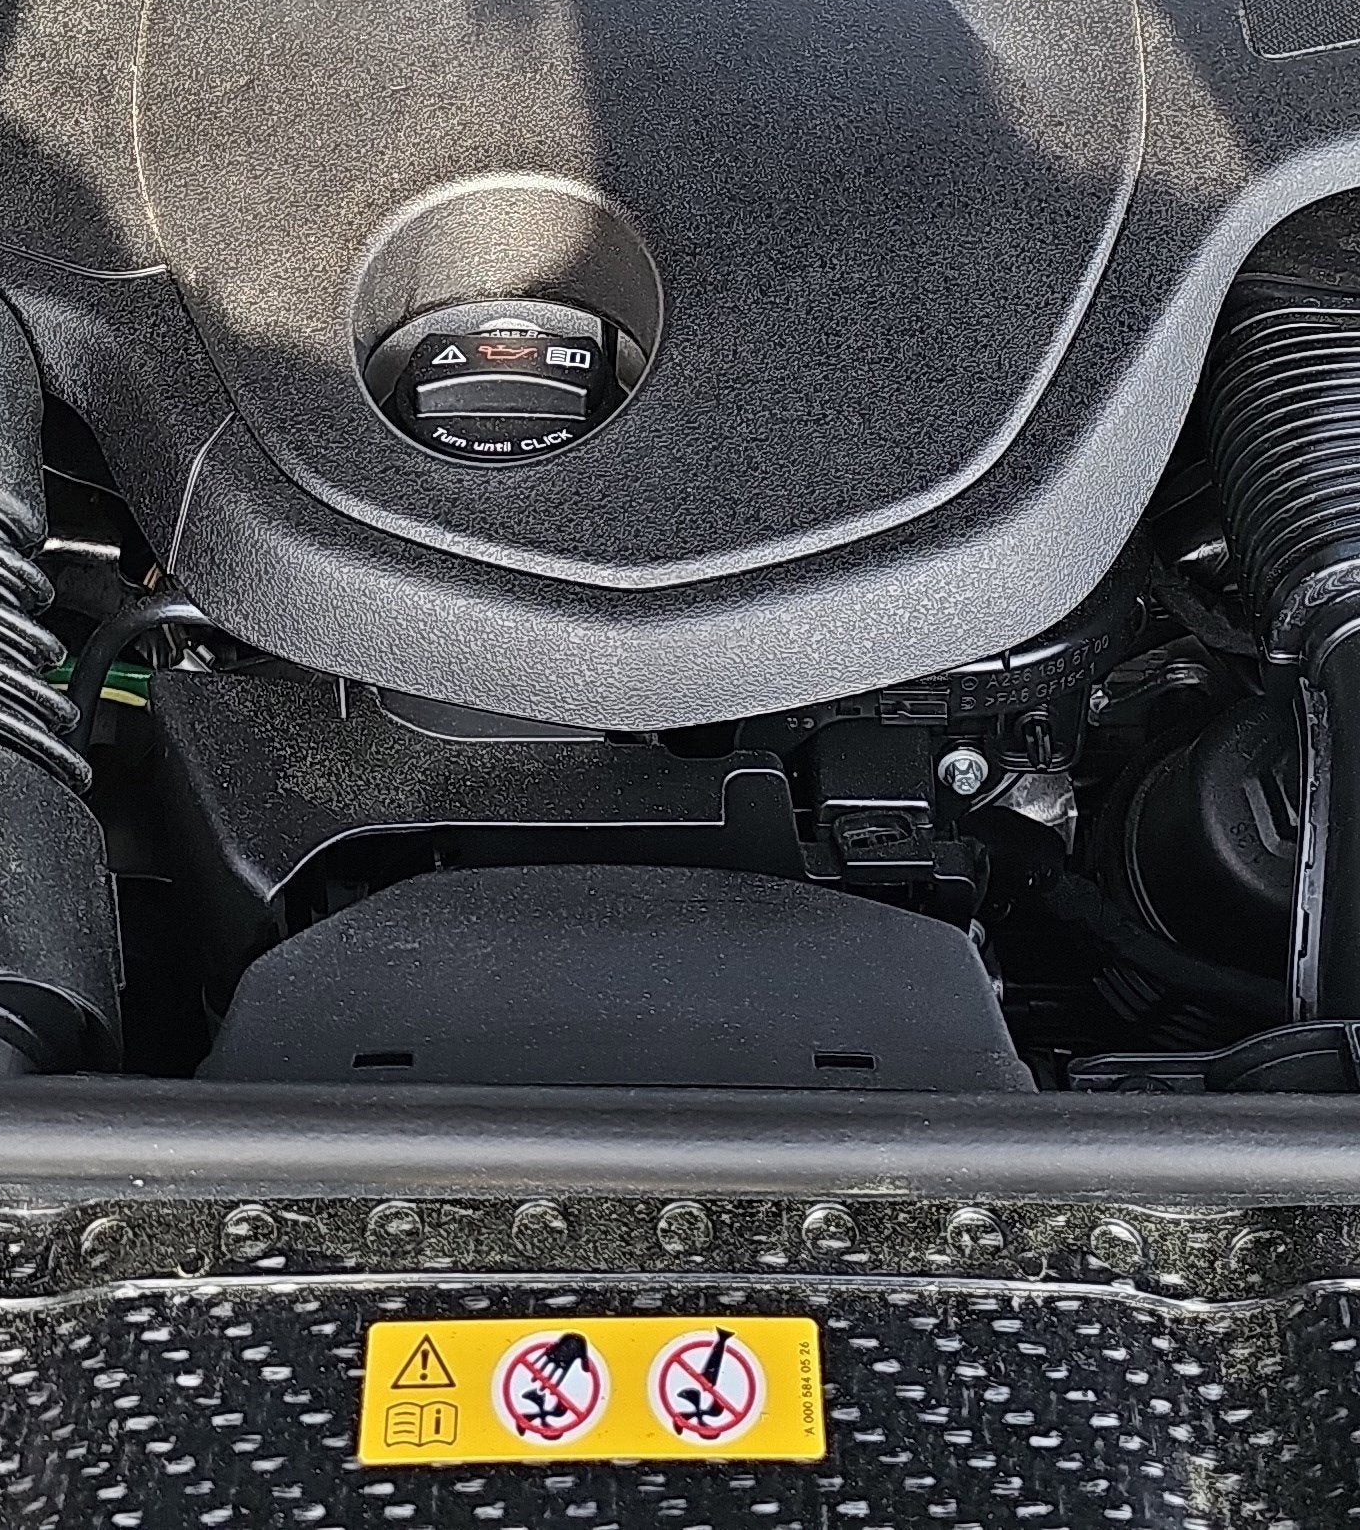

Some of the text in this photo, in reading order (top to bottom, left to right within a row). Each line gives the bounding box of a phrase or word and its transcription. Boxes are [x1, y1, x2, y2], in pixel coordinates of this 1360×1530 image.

[432, 426, 574, 453] Turn until CLICK
[799, 1341, 815, 1436] A 000 584 05 26
